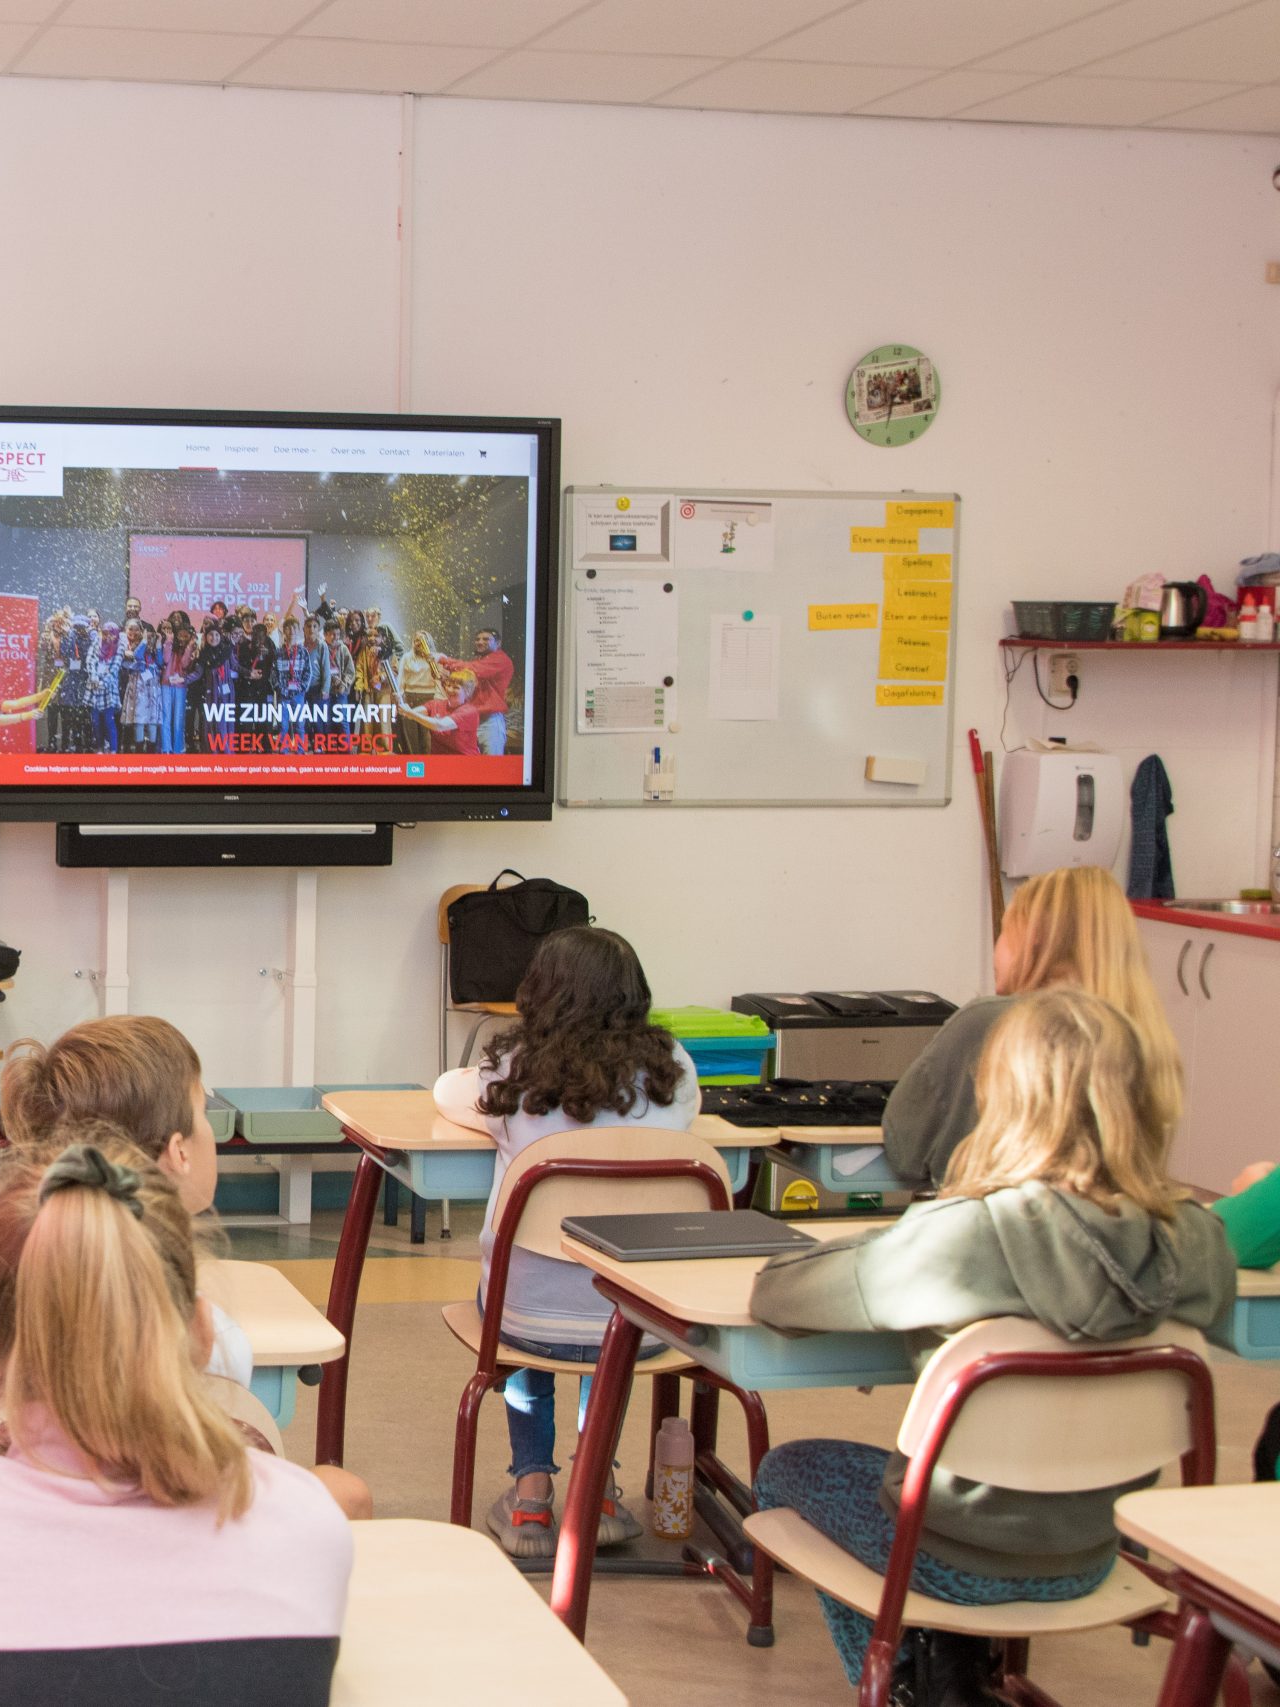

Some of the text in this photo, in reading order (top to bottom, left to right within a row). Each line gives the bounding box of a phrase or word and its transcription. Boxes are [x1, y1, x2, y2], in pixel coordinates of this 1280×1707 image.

[16, 441, 37, 451] VAN
[185, 443, 211, 452] Home
[273, 445, 289, 454] Doe
[330, 446, 348, 455] Over
[379, 447, 410, 457] Contact
[423, 449, 465, 458] Materialen
[852, 534, 872, 544] Eten
[902, 557, 933, 568] Spelling
[173, 571, 243, 593] WEEK
[247, 583, 270, 593] 2022
[165, 591, 186, 602] VAN
[845, 612, 871, 621] spelen
[884, 611, 904, 621] Eten
[897, 637, 931, 648] Rekenen
[895, 664, 930, 673] Creatief
[203, 703, 397, 723] WE ZIJN VAN START!
[207, 733, 397, 752] WEEK VAN RESPECT
